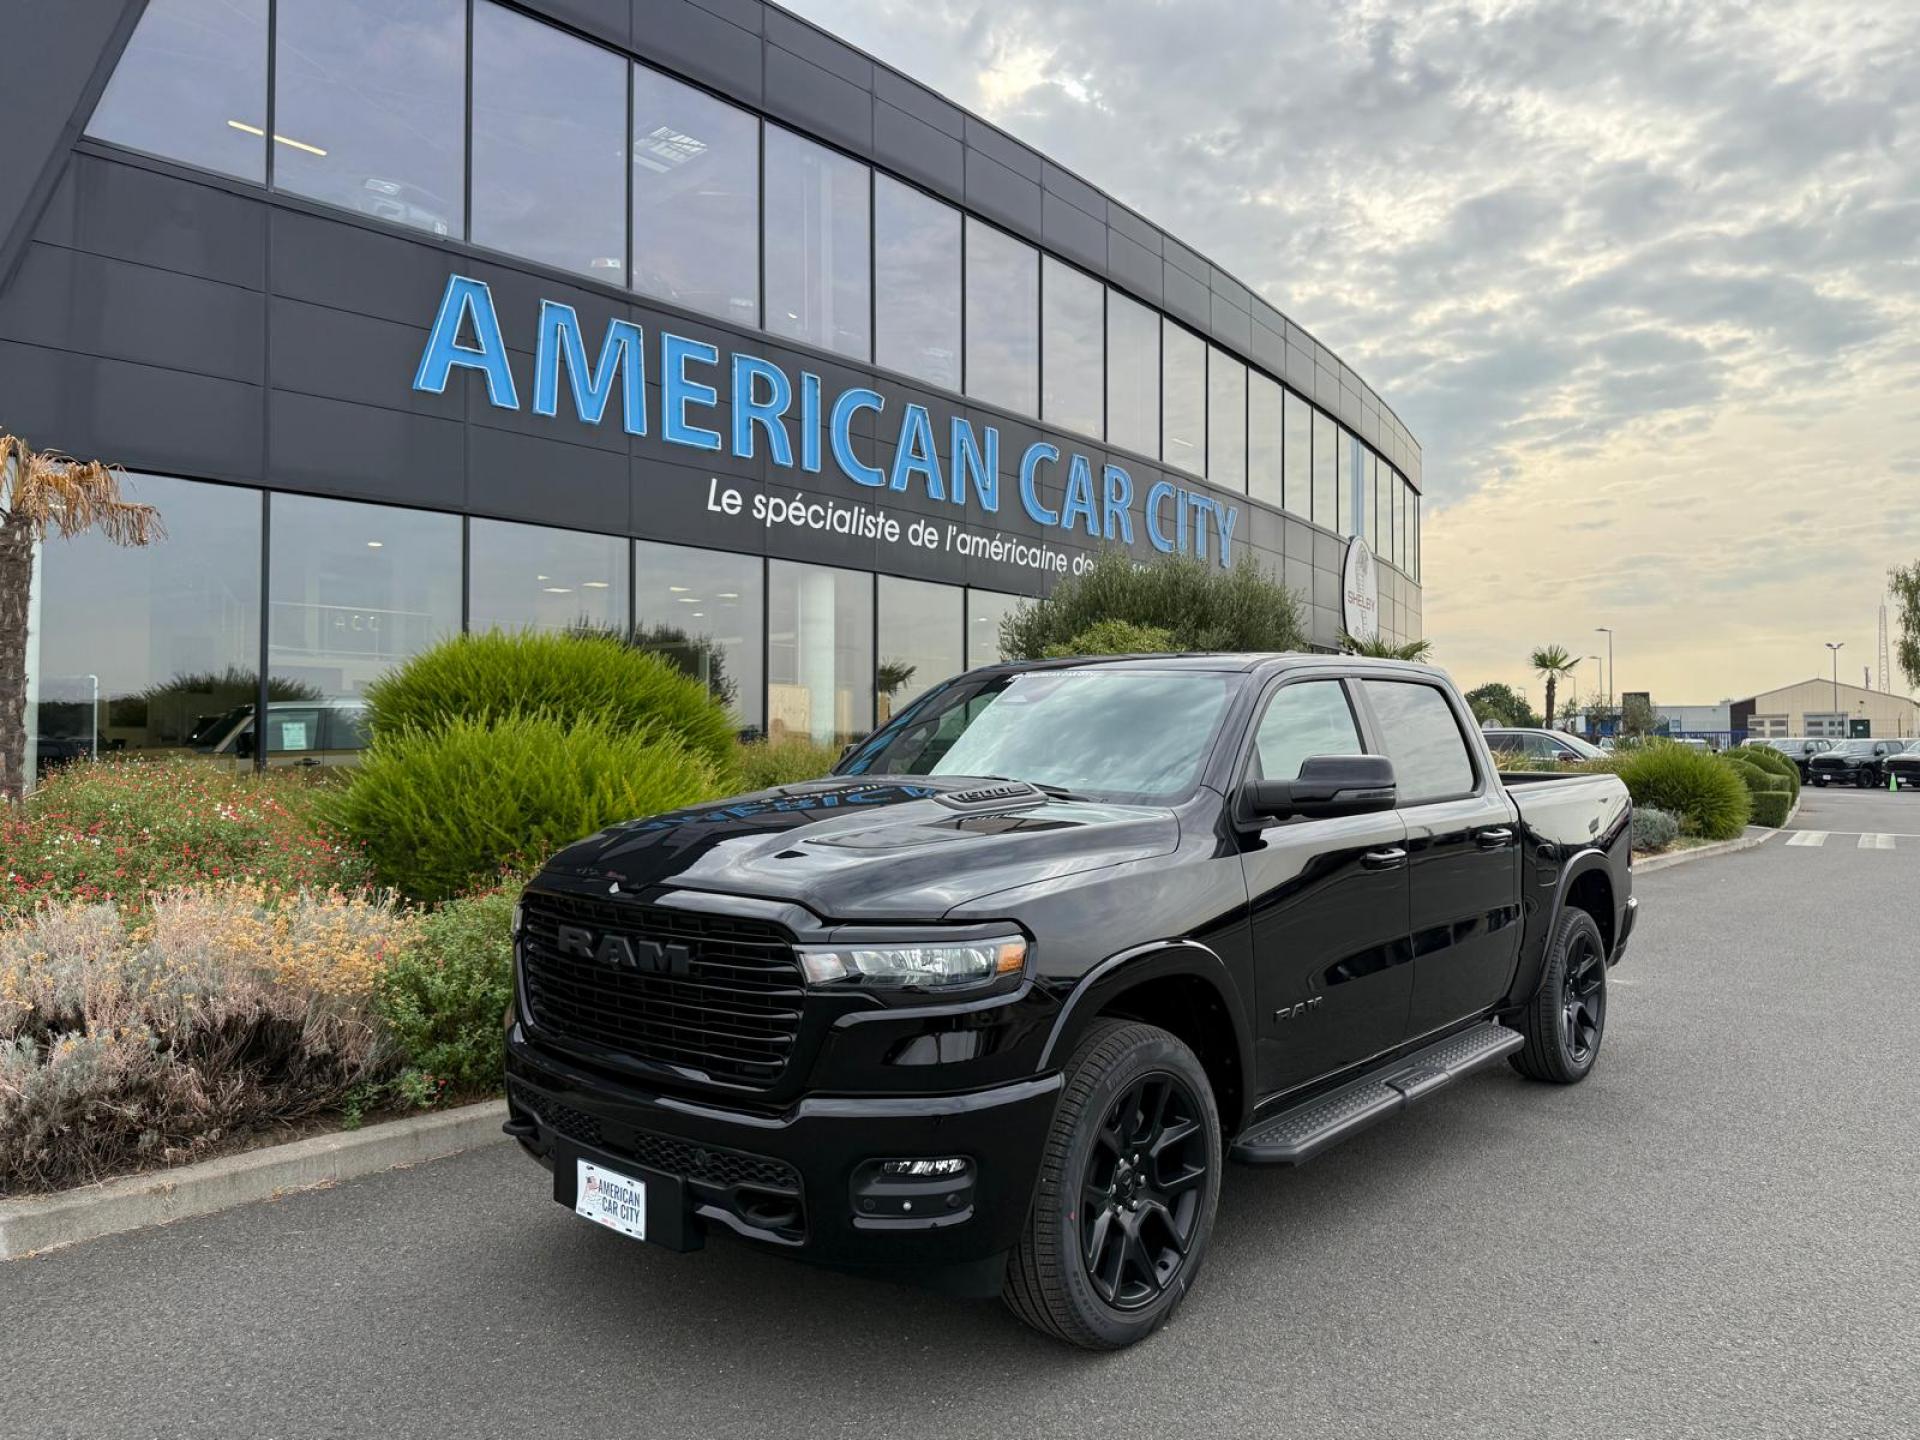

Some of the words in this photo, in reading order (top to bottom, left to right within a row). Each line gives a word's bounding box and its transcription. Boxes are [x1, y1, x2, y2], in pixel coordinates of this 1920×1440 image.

[413, 273, 998, 512] AMERICAN
[1020, 442, 1134, 544] CAR
[1146, 481, 1238, 568] CITY
[707, 478, 743, 515] Le
[752, 492, 900, 542] spécialiste
[908, 519, 939, 549] de
[946, 525, 1067, 573] l'américaine
[558, 924, 689, 975] RAM
[1274, 996, 1323, 1019] RAM
[598, 1178, 641, 1208] AMERICAN
[602, 1197, 618, 1217] CAR
[620, 1204, 640, 1224] CITY
